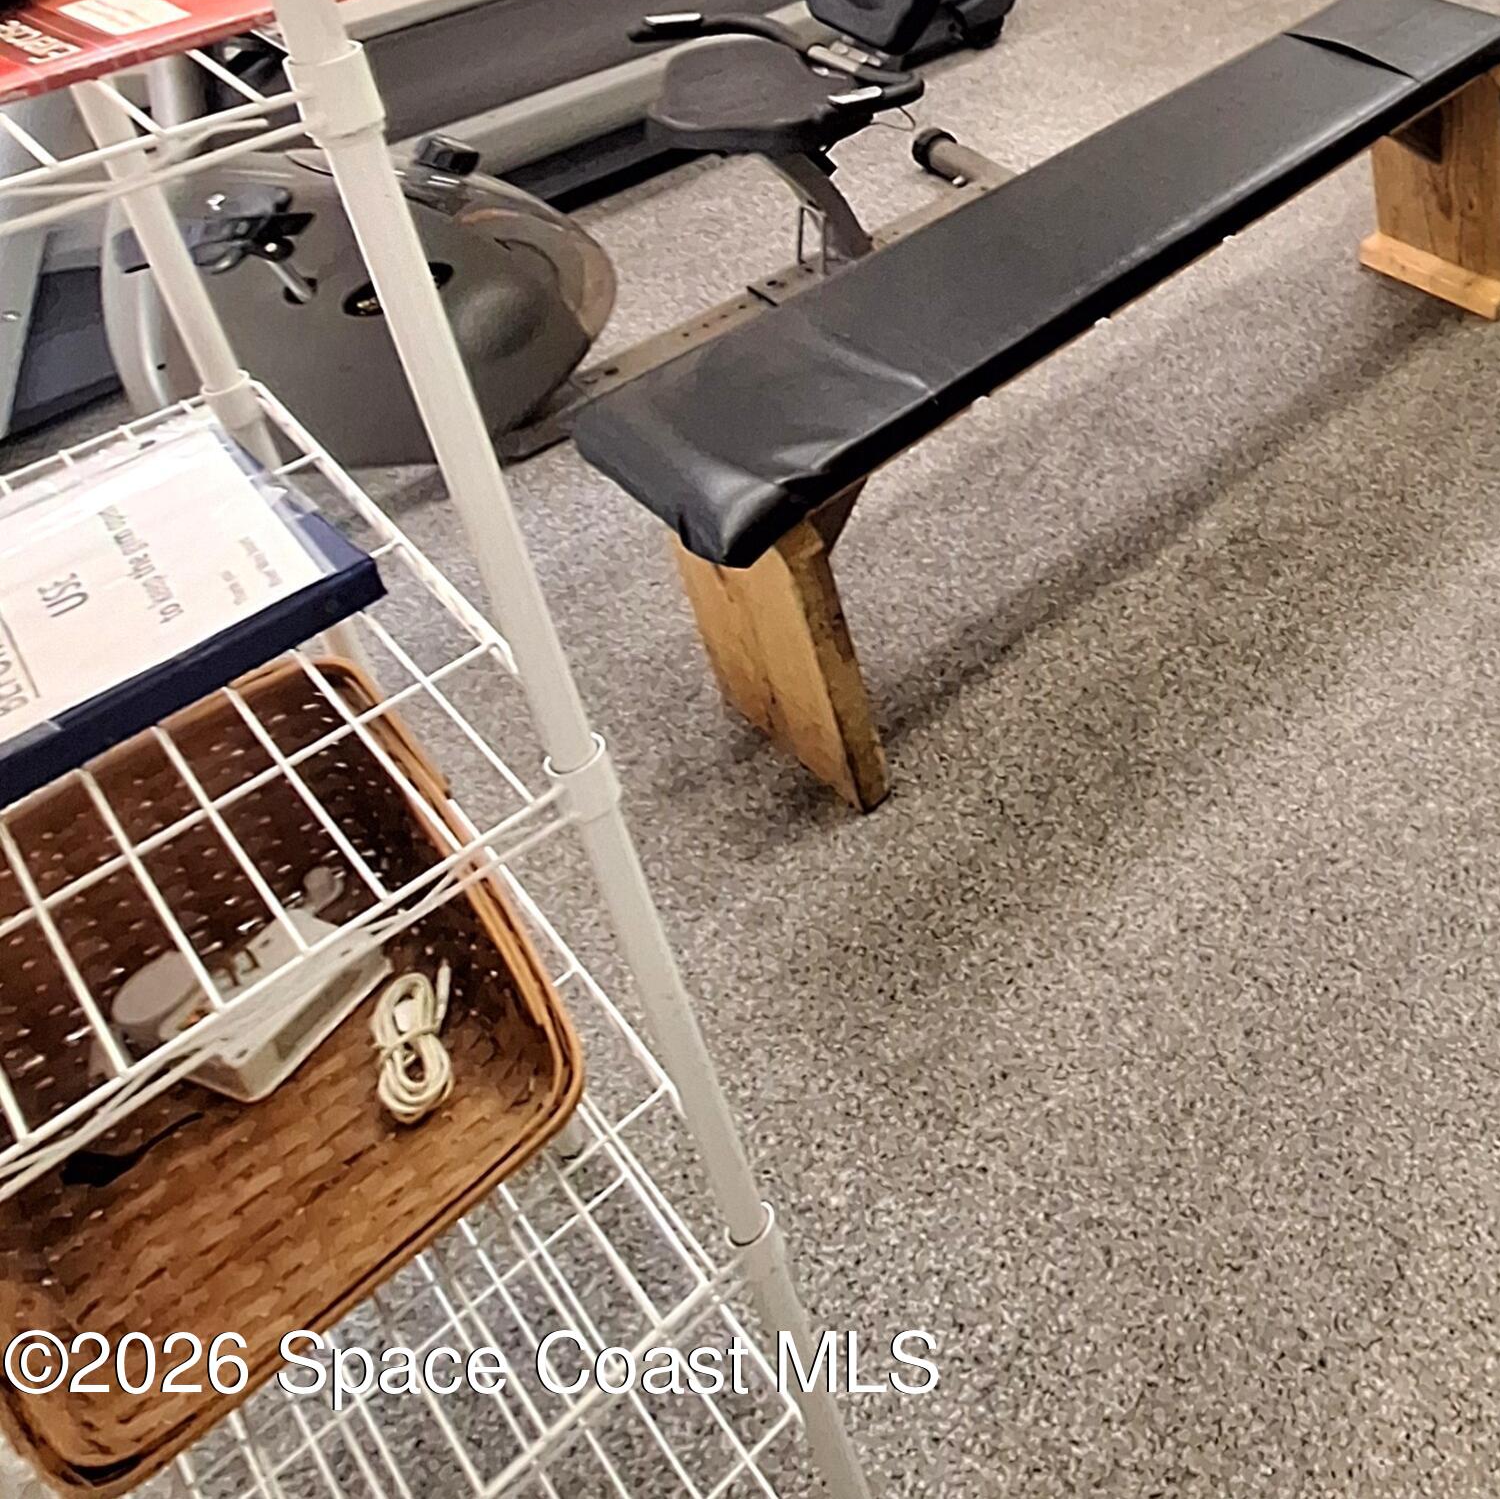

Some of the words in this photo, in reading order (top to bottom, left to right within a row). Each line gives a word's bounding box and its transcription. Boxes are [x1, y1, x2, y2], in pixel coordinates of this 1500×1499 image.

[127, 553, 156, 580] the
[37, 572, 89, 618] USE
[158, 603, 184, 623] to
